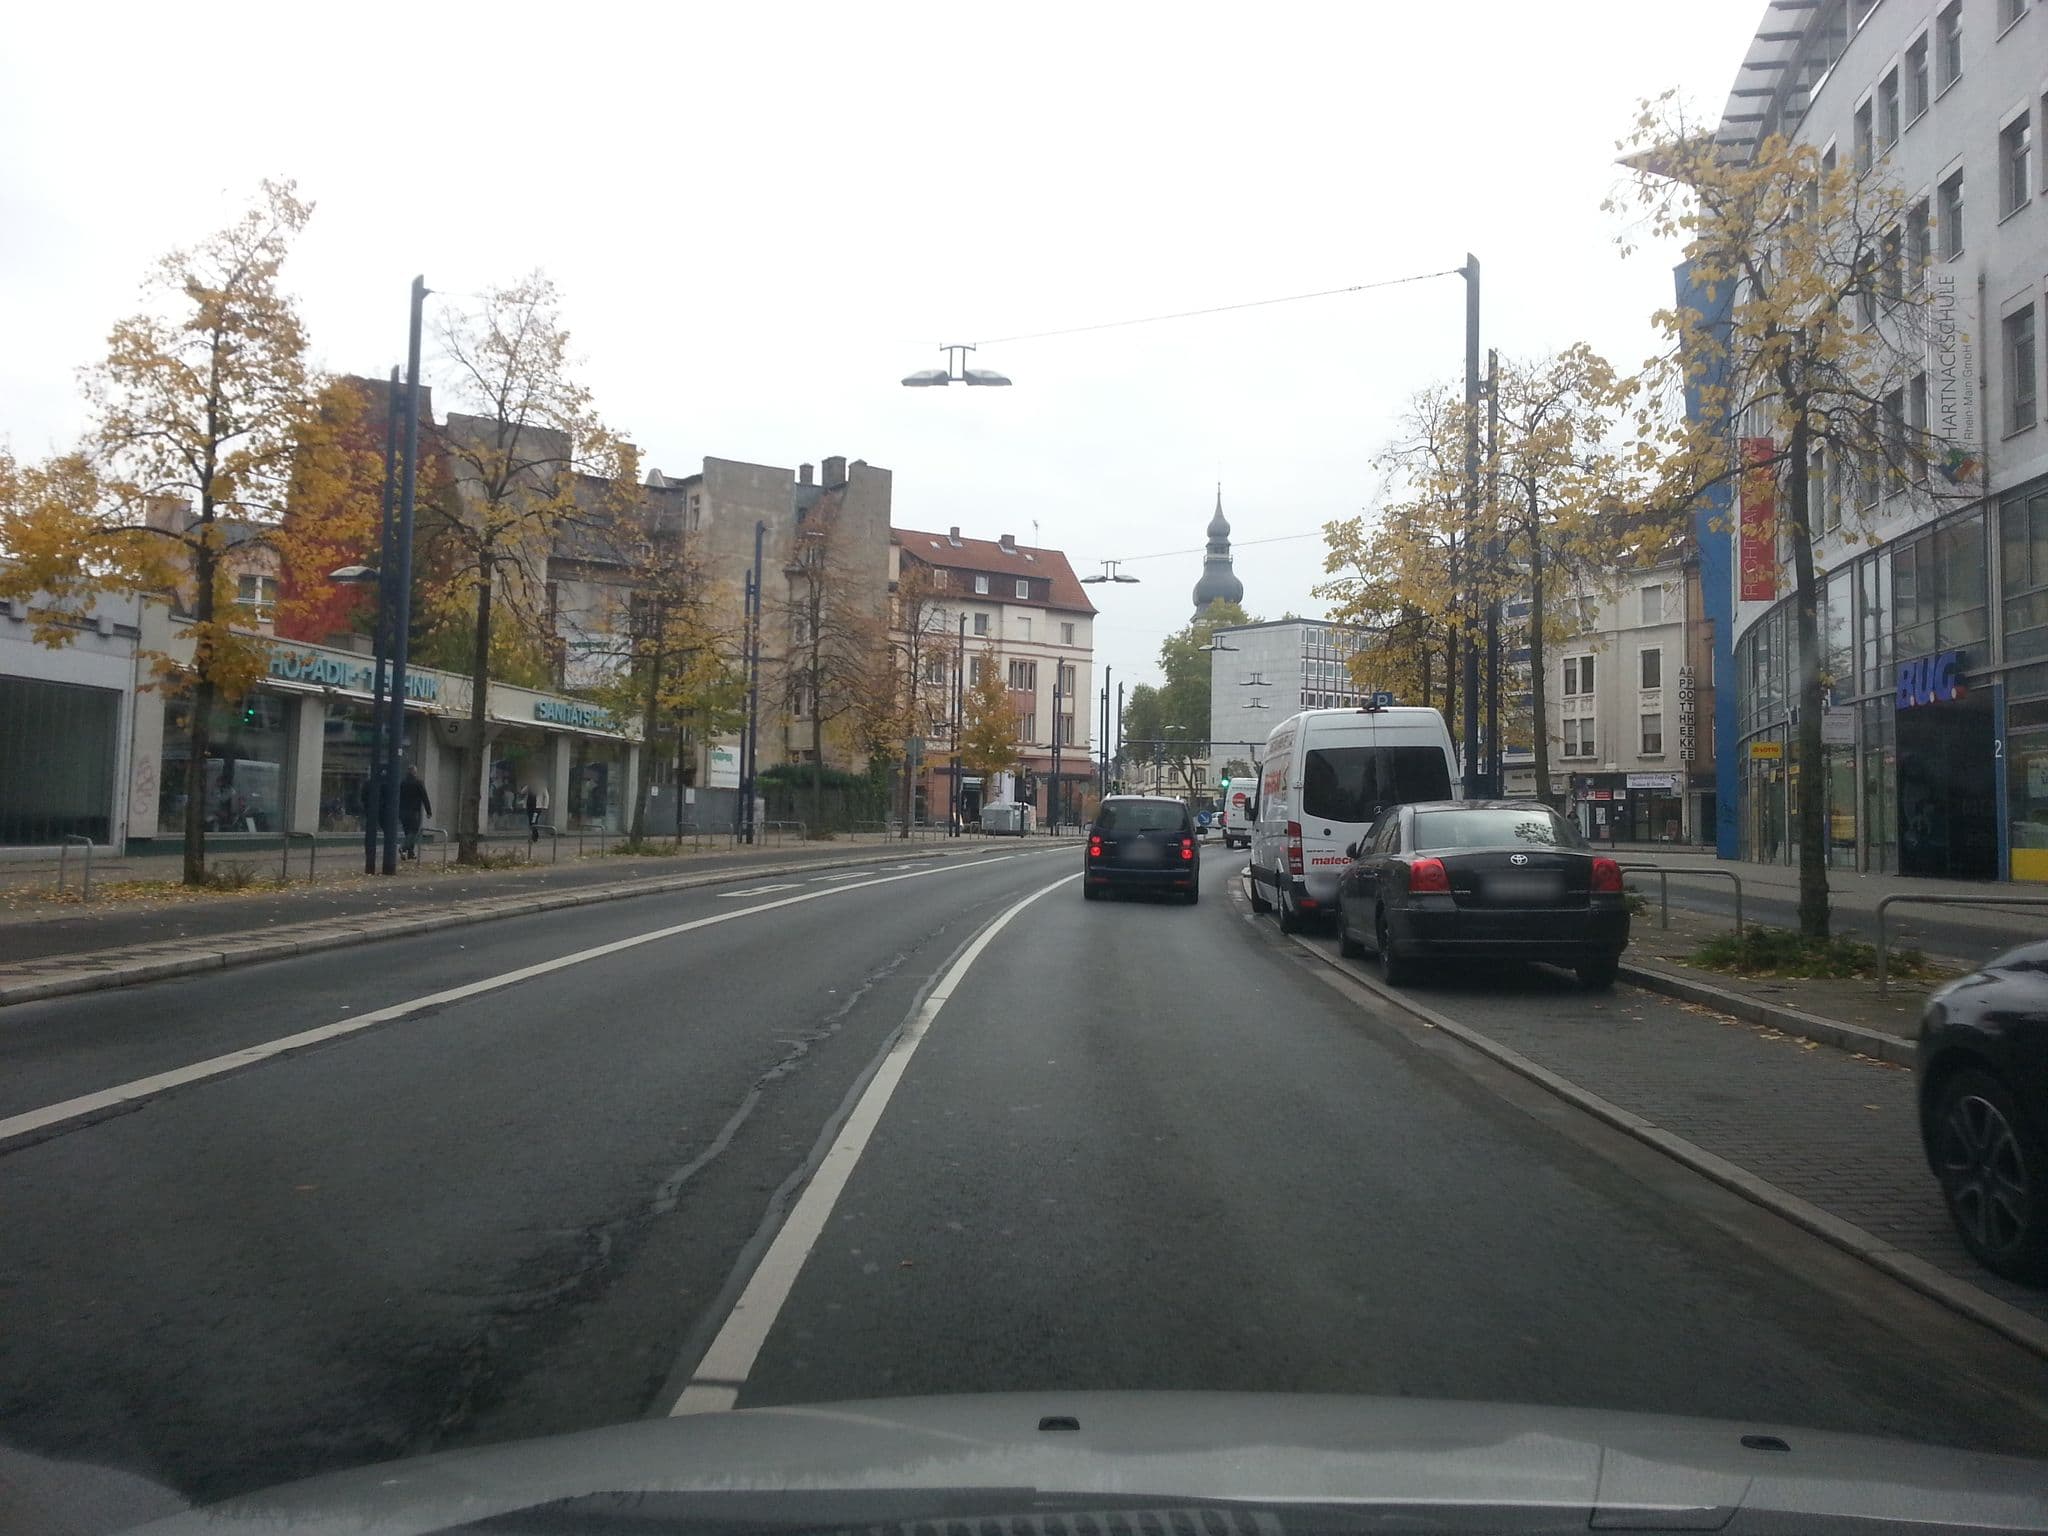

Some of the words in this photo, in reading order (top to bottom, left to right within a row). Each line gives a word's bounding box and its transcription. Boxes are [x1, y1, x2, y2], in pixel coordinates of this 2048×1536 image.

[1938, 275, 1957, 441] HARTNACKSCHULE
[1962, 344, 1973, 376] GmbH
[1963, 376, 1974, 440] Rhein-Main
[1377, 694, 1388, 706] P
[1679, 666, 1687, 760] APOTHEKE
[1995, 739, 2002, 758] 2
